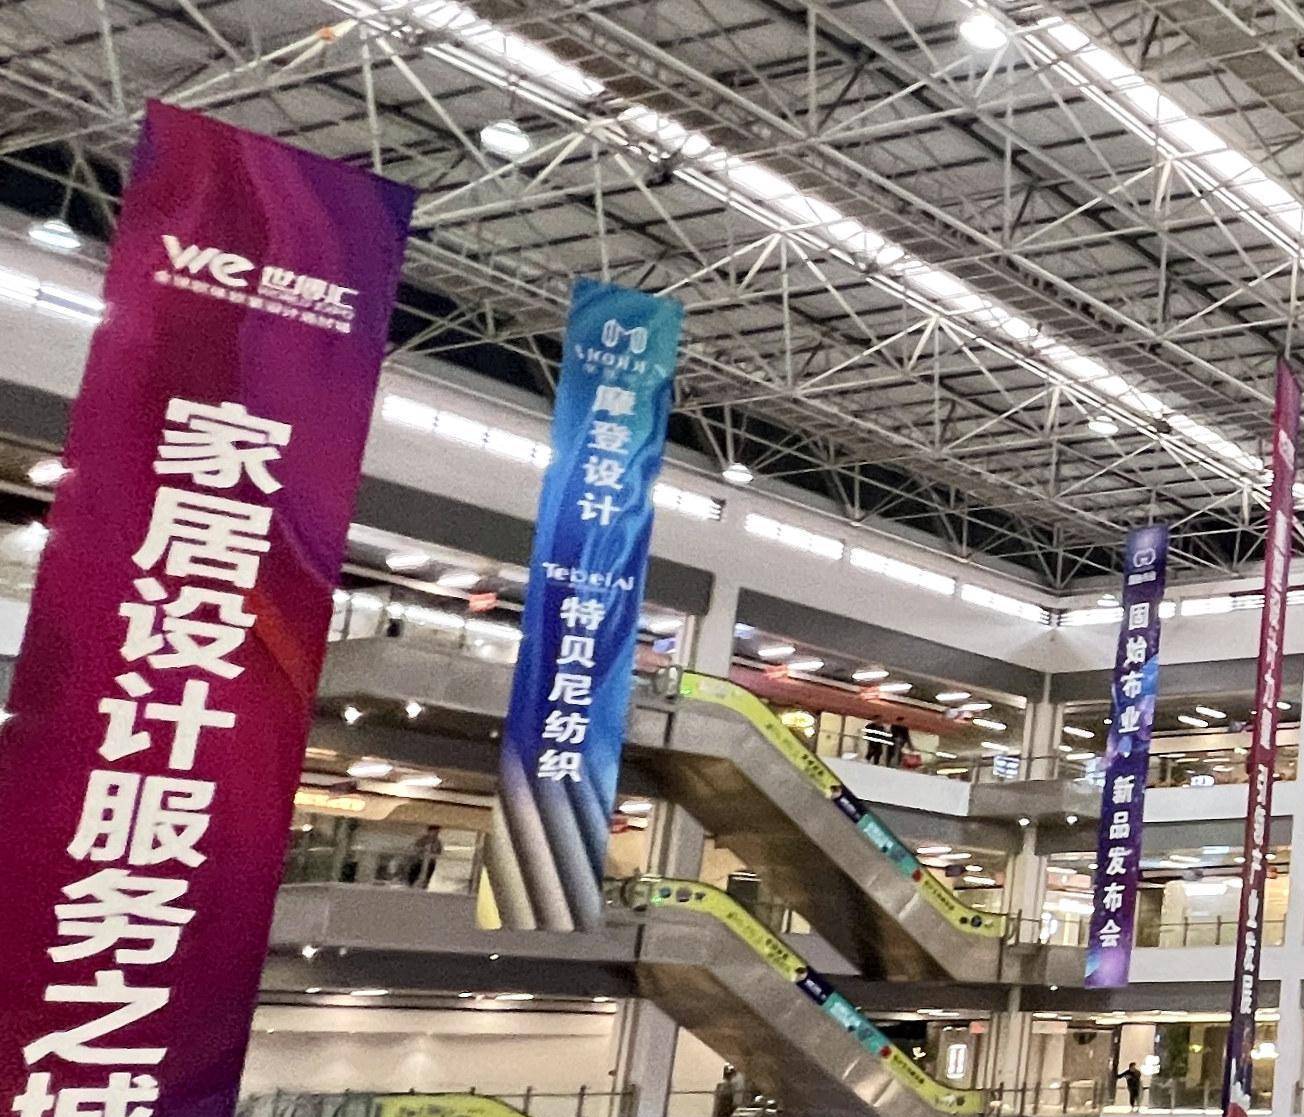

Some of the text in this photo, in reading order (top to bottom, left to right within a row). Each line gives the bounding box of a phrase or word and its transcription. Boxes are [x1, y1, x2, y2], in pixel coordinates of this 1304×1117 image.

[537, 596, 605, 784] 特贝尼纺织
[1099, 774, 1136, 948] 新品发布会
